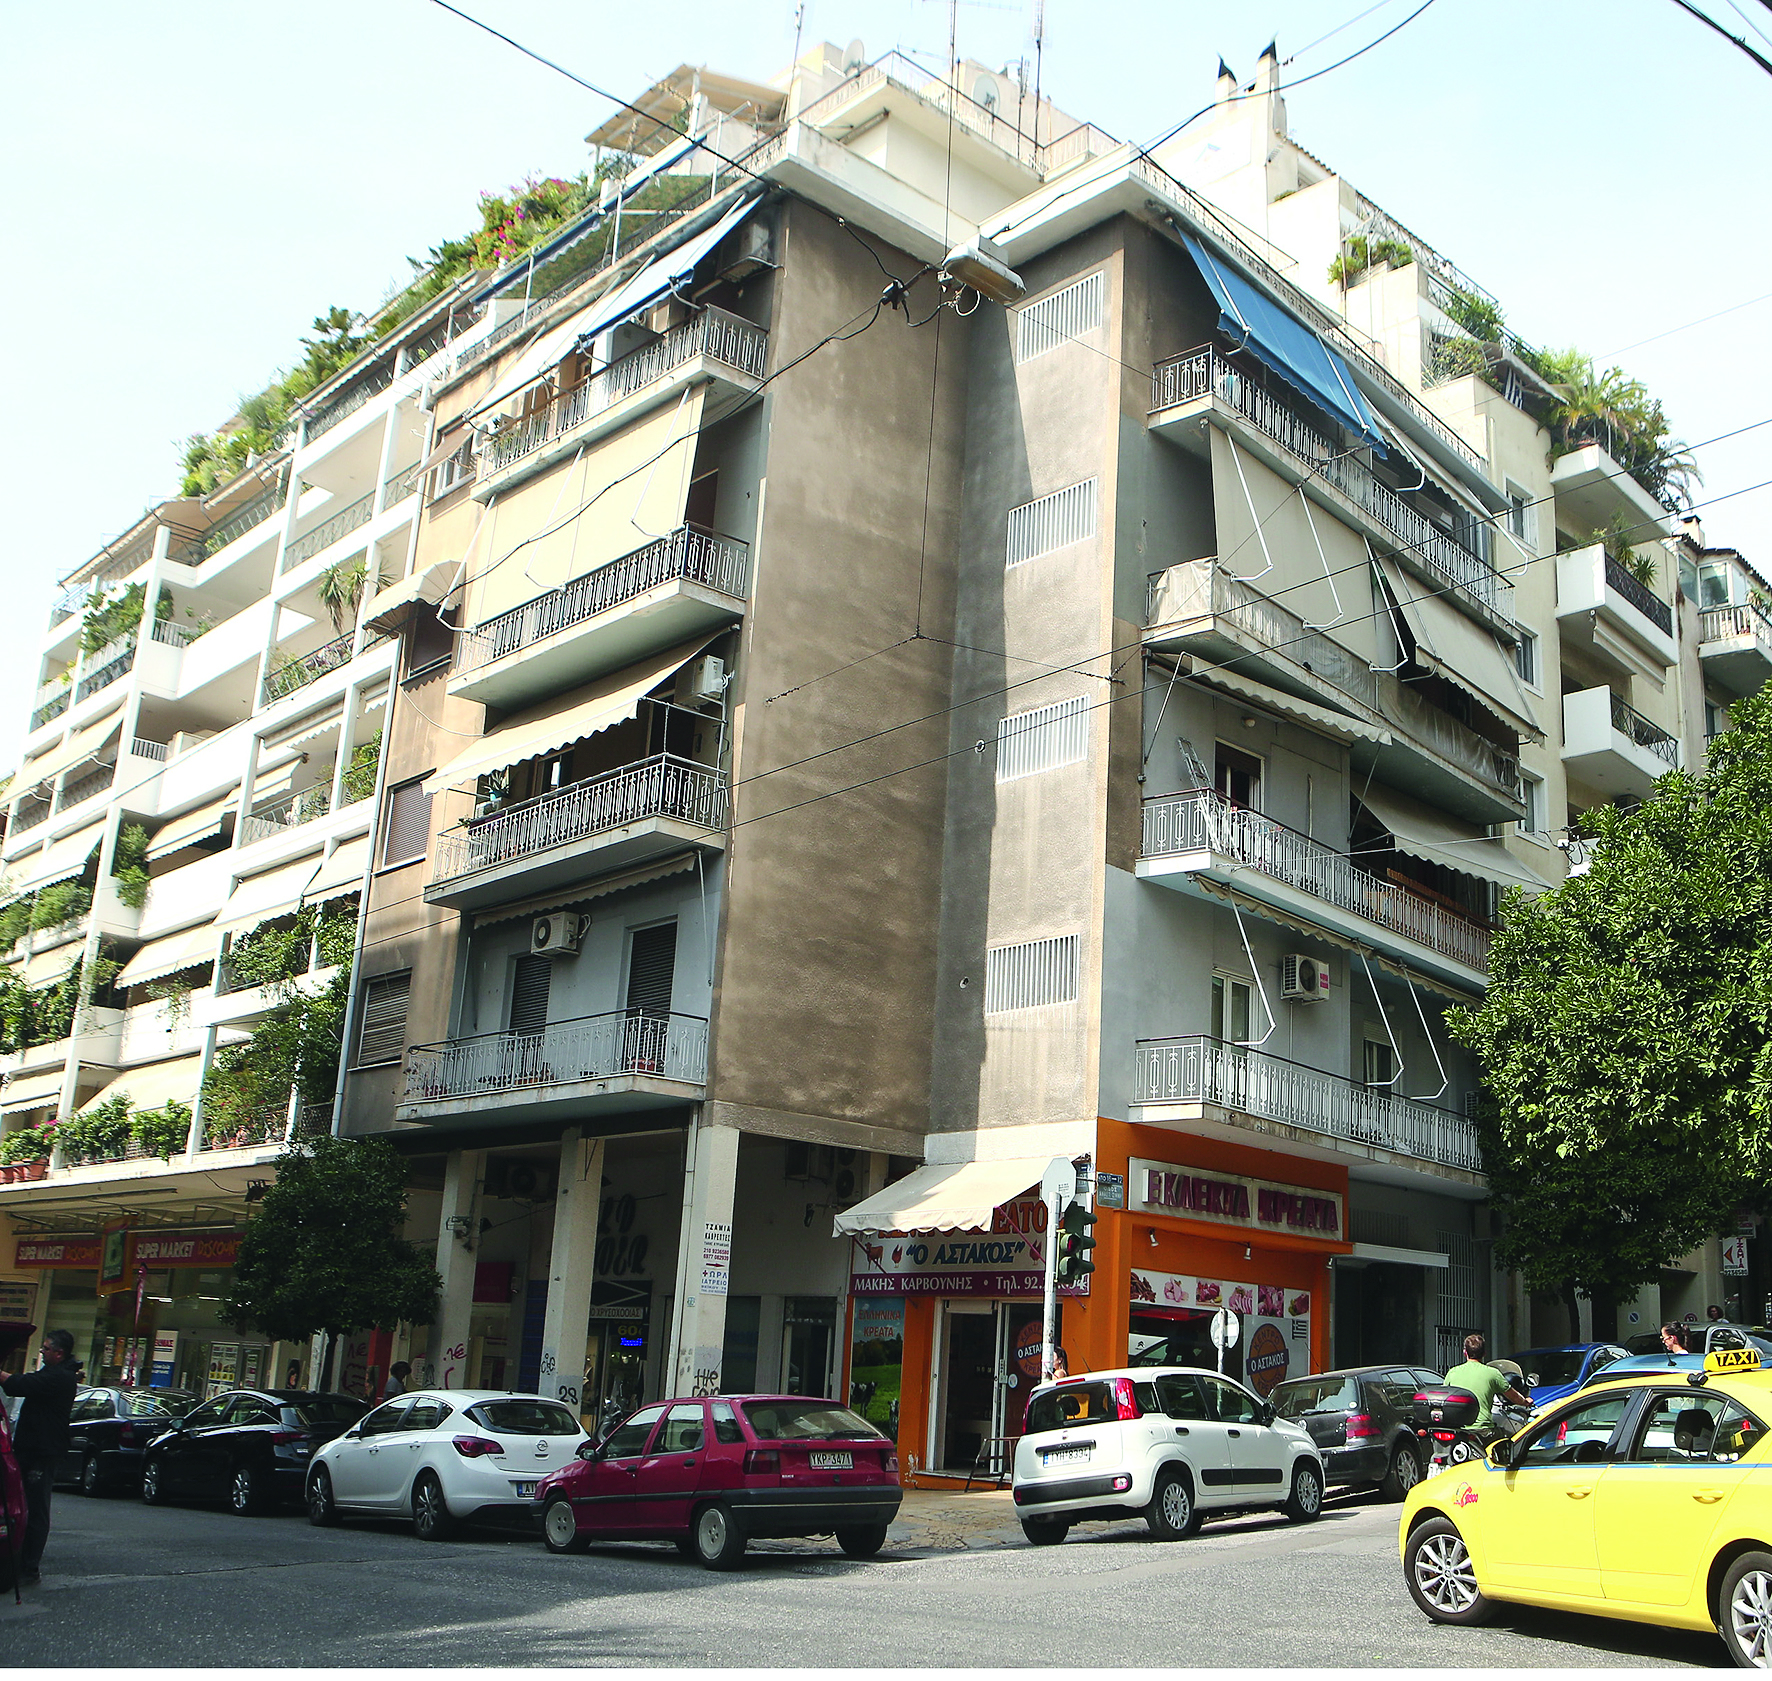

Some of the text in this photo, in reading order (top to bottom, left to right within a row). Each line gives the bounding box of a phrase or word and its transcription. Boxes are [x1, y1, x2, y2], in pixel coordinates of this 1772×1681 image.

[1142, 1168, 1339, 1231] ΕΚΛΕΚΤΑ ΚΡΕΑΤΑ
[705, 1223, 730, 1232] ΤΖΑΜΙΑ
[18, 1245, 37, 1260] SUPER
[36, 1245, 65, 1260] MARKET
[136, 1242, 160, 1259] SUPER
[159, 1241, 195, 1258] MARKET
[701, 1278, 727, 1286] ΙΑΤΡΕΙΟ
[854, 1277, 895, 1291] ΜΑΚΗΣ
[901, 1276, 973, 1291] ΚΑΡΒΟΥΝΗΣ
[996, 1275, 1021, 1294] Τηλ.
[859, 1309, 900, 1321] ΕΛΛΗΝΙΚΑ
[863, 1326, 894, 1337] ΚΡΕΑΤΑ
[1017, 1343, 1042, 1359] Ο ΑΣΤΑ
[1717, 1351, 1757, 1367] TAXI
[1251, 1352, 1285, 1372] Ο ΑΣΤΑΚΟΣ
